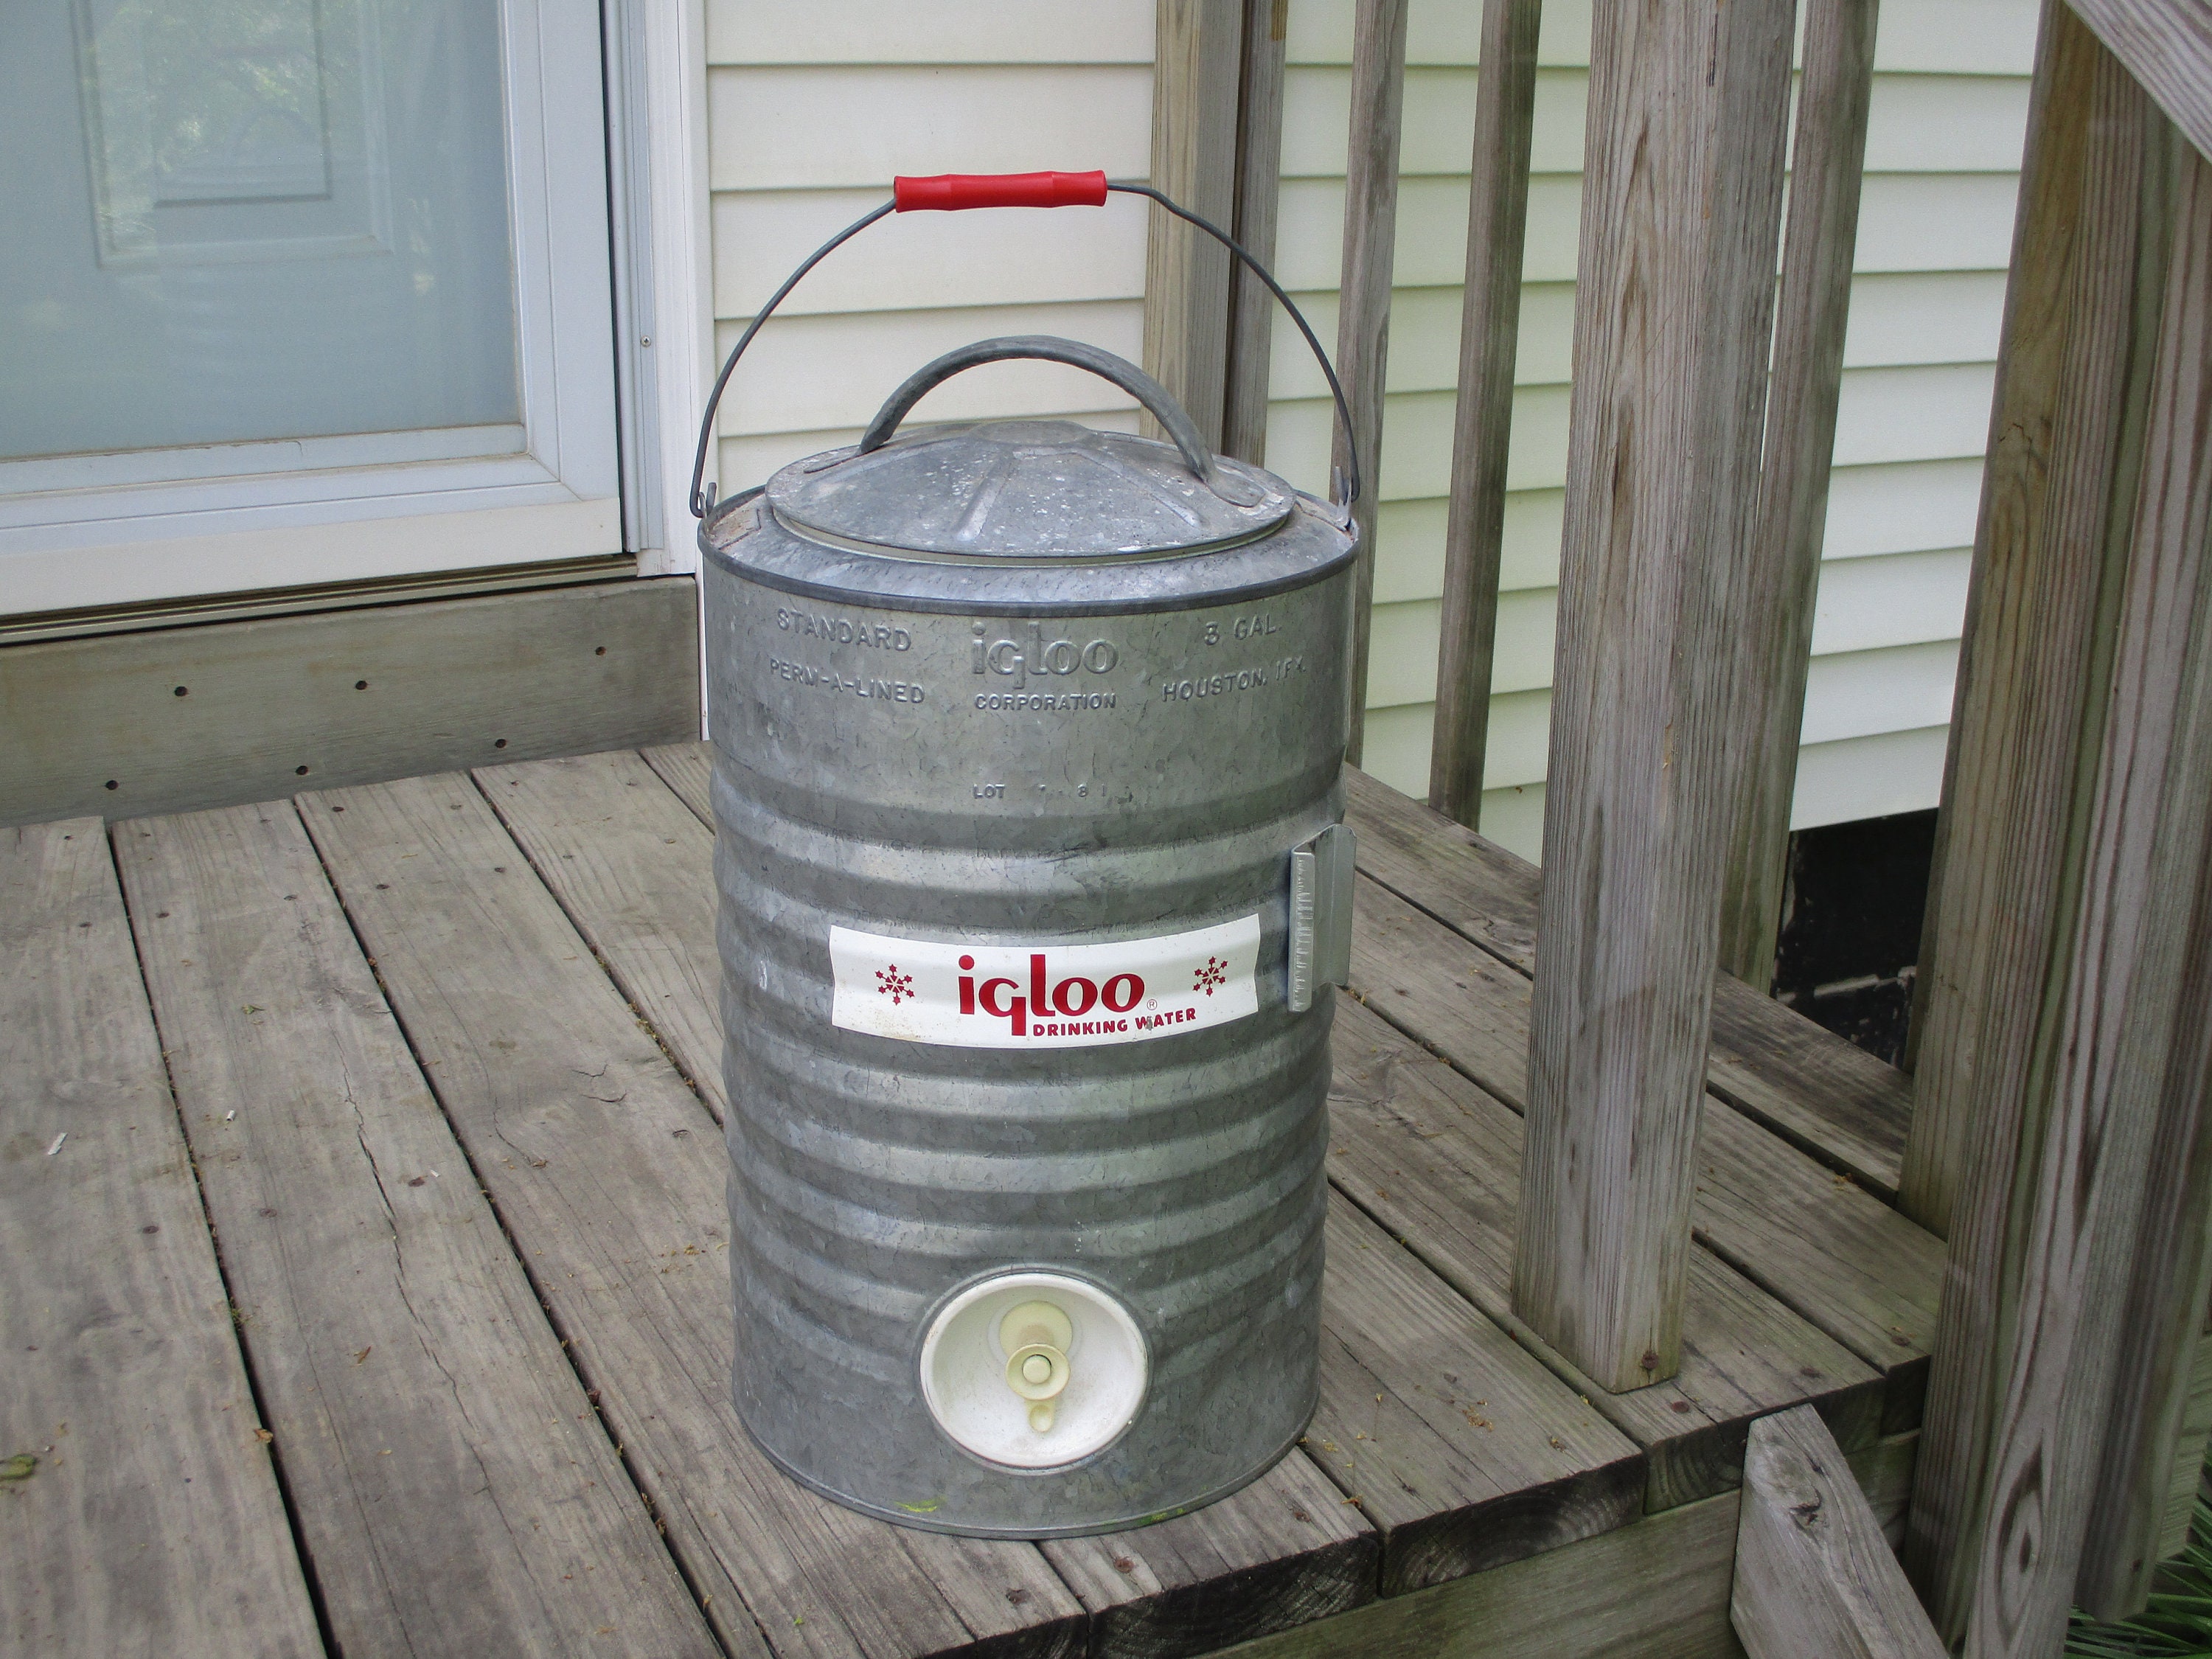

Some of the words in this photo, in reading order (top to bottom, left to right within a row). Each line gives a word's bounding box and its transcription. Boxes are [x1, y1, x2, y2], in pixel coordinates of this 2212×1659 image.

[776, 608, 912, 652] STANDARD
[1203, 620, 1220, 646] 3
[971, 621, 1119, 689] igloo
[974, 692, 1117, 711] CORPORATION
[972, 783, 1006, 799] LOT
[959, 953, 1146, 1037] igloo
[1033, 1018, 1128, 1037] DRINKING
[1135, 1007, 1197, 1030] WATER
